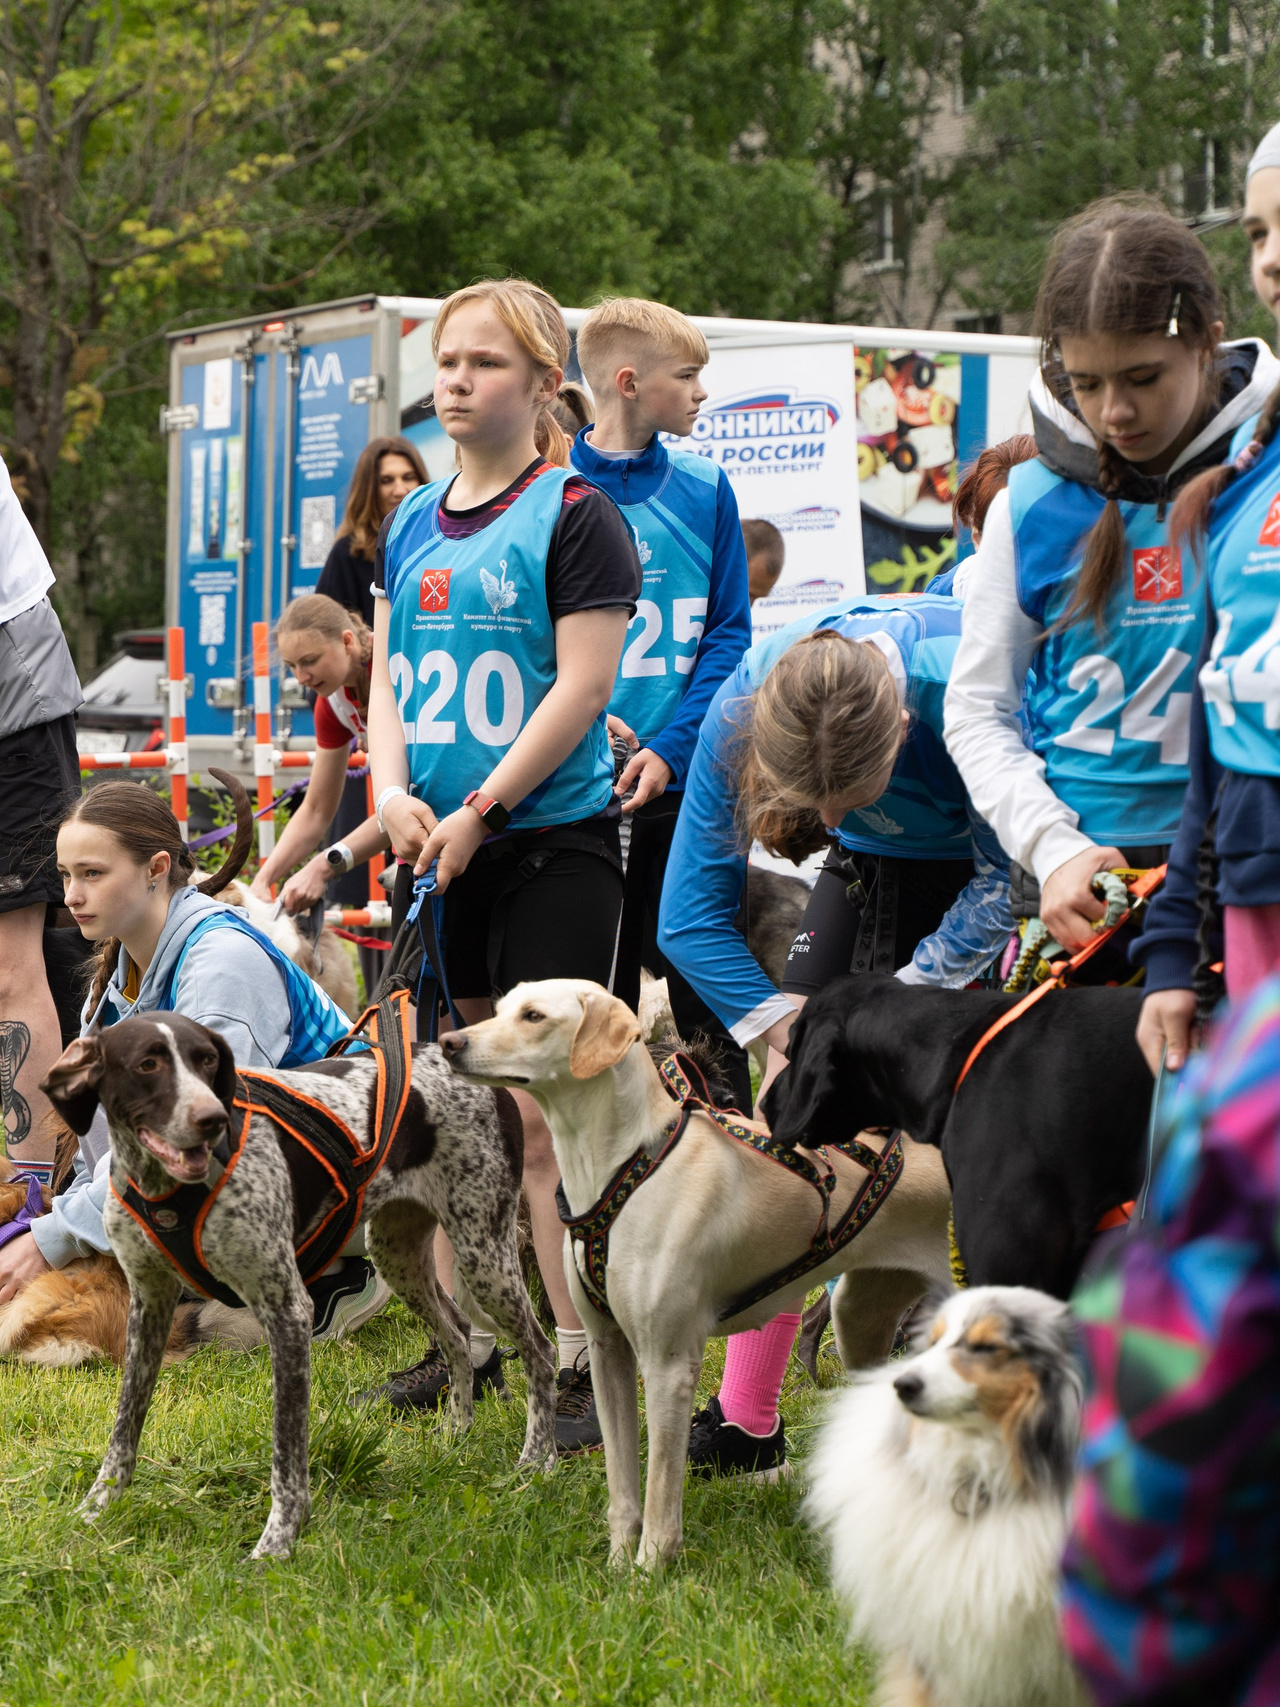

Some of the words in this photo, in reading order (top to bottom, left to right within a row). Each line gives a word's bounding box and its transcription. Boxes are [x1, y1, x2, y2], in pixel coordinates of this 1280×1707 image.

[722, 442, 825, 464] РОССИИ
[415, 614, 452, 622] Правительство
[463, 613, 487, 621] Комитет
[497, 614, 532, 625] физической
[1121, 613, 1196, 627] Санкт-Петербурга
[411, 622, 455, 631] Санкт-Петербурга
[470, 624, 498, 632] культуре
[504, 625, 523, 633] спорту
[388, 649, 525, 747] 220
